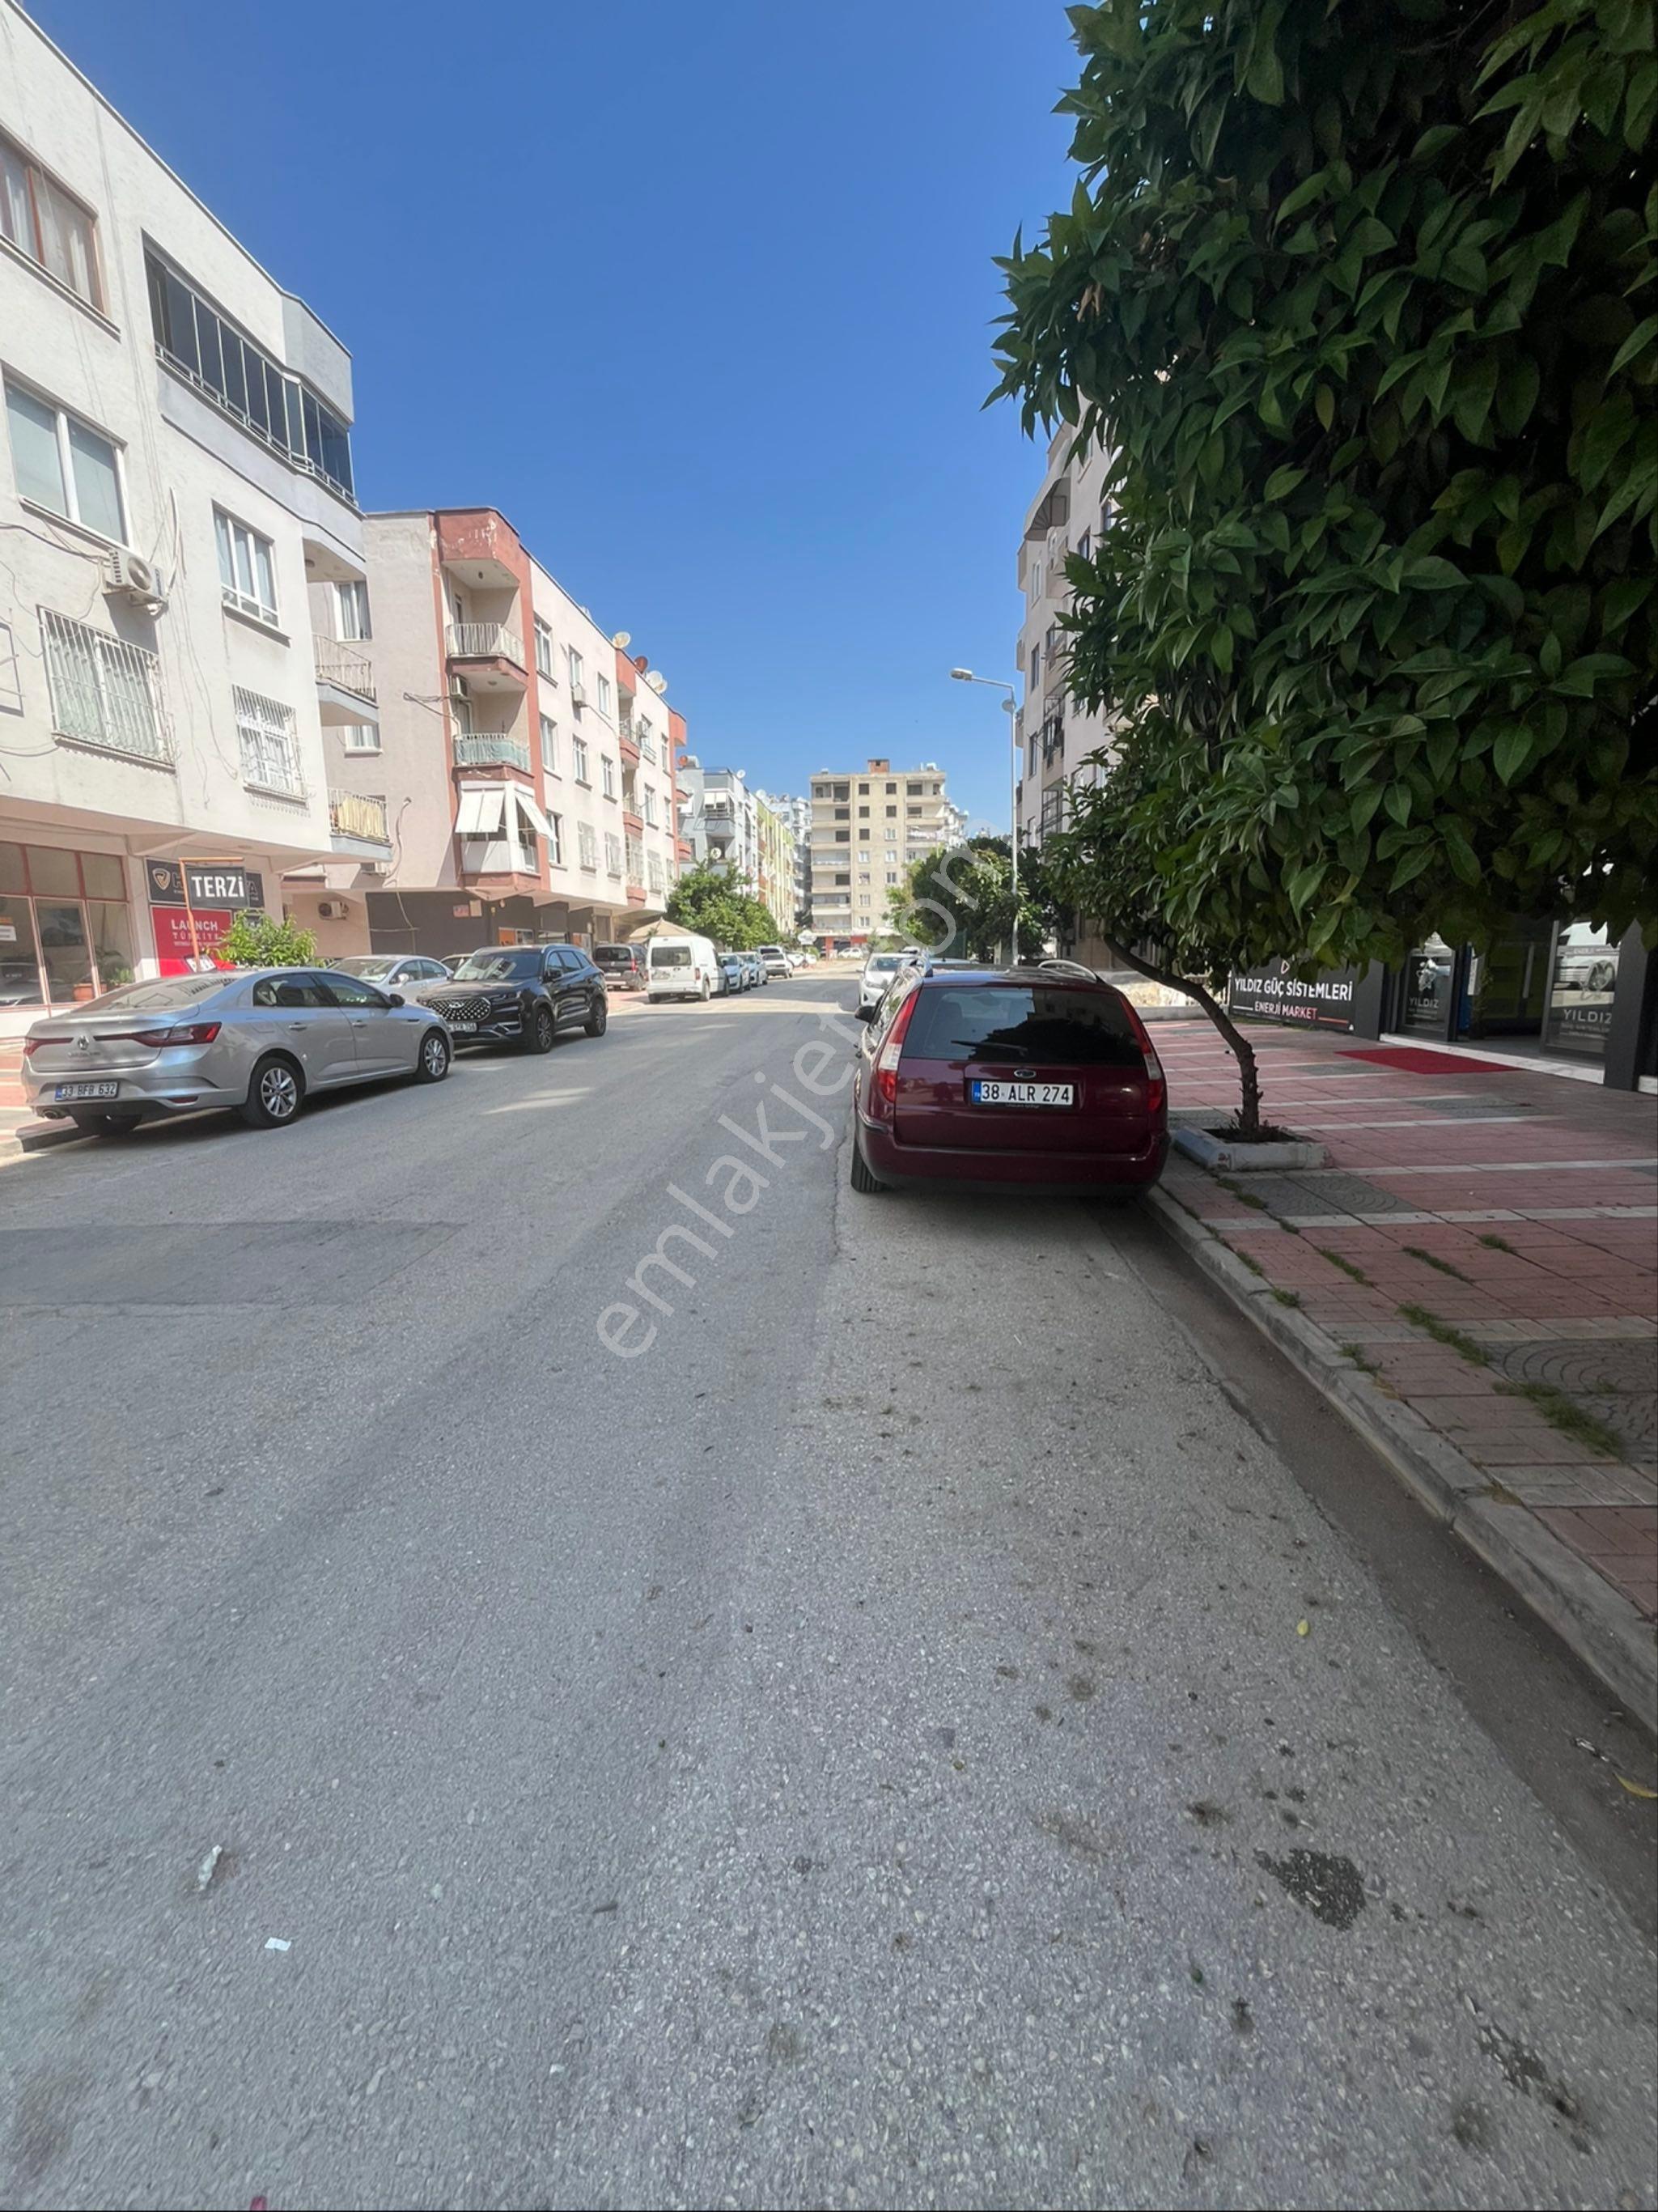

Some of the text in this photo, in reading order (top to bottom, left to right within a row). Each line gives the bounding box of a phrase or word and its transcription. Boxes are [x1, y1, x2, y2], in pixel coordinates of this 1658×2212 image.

[1235, 977, 1354, 1001] YILDIZ GÜÇ SİSTEMLERİ
[1255, 1001, 1318, 1020] ENERJİ MARKET
[1409, 996, 1440, 1008] YILDIZ
[1563, 1008, 1613, 1024] YILDIZ
[982, 1084, 1070, 1102] 38 ALR 274
